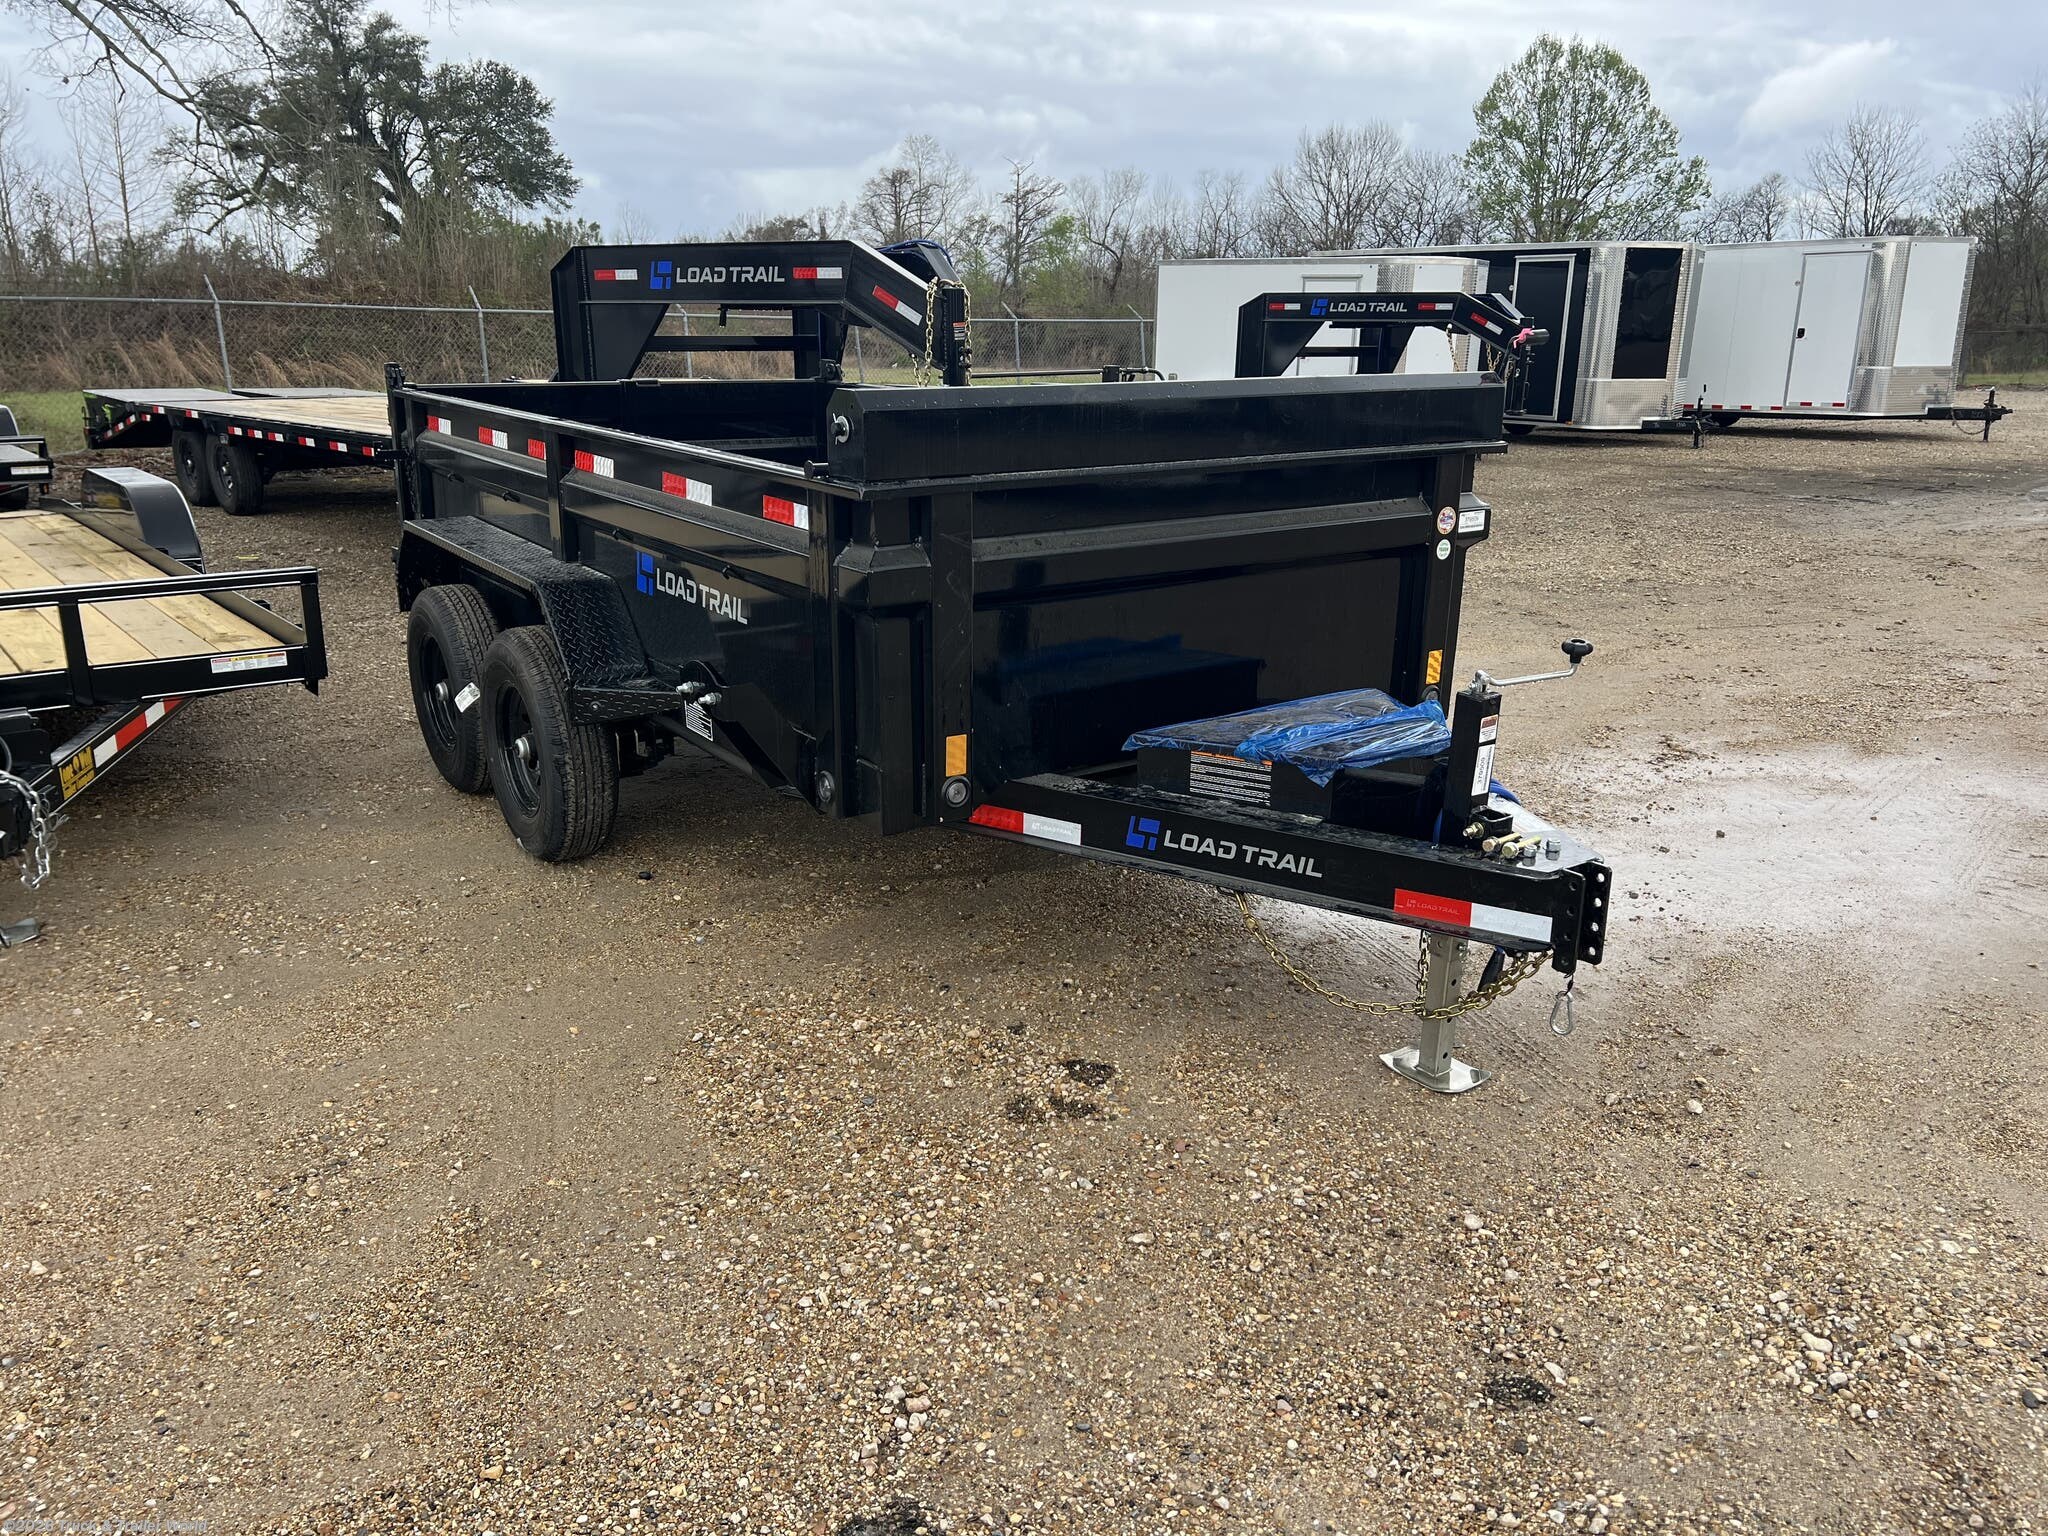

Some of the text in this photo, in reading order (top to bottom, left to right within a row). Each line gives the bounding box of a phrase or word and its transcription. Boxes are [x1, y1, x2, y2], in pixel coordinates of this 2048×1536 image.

[676, 266, 785, 283] LOAD TRAIL
[1329, 302, 1407, 312] LOAD TRAIL
[656, 567, 748, 625] LOAD TRAIL
[1163, 829, 1323, 878] LOAD TRAIL
[1417, 903, 1460, 915] LOAD TRAIL
